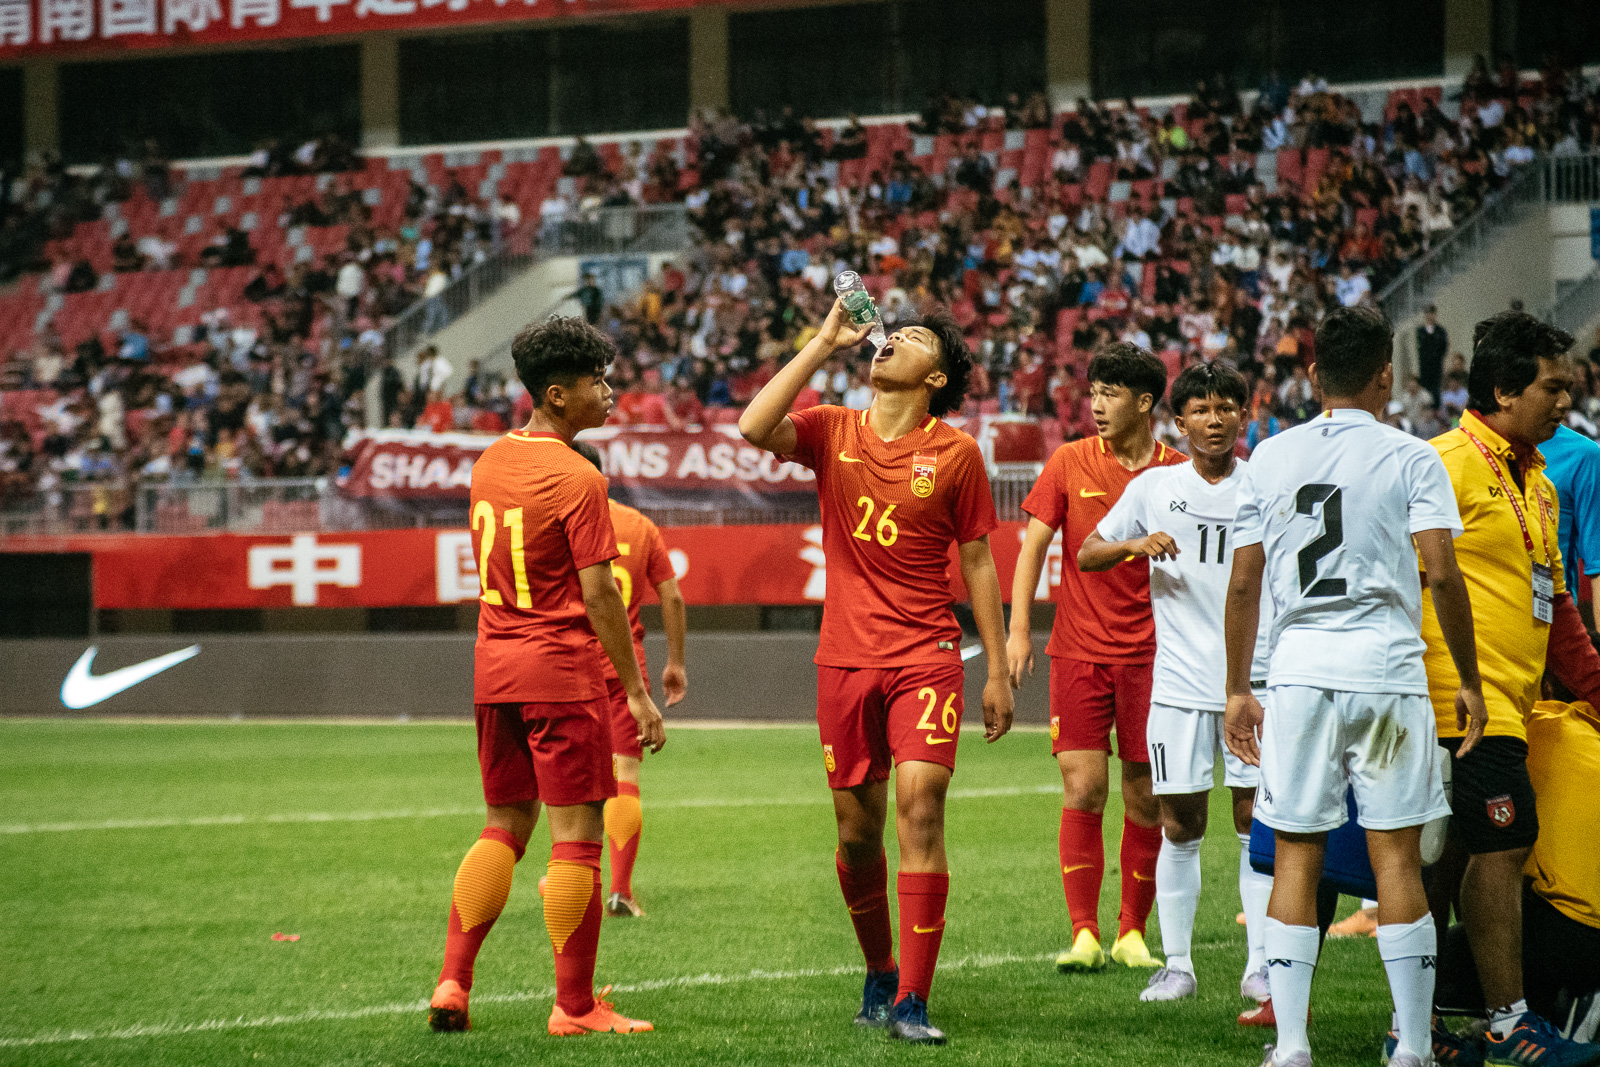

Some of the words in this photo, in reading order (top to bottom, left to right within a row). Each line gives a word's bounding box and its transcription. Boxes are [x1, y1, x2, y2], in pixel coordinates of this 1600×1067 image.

[370, 453, 472, 489] SHAA
[600, 441, 669, 478] NS
[853, 496, 898, 547] 26
[1197, 524, 1227, 564] 11
[1296, 484, 1347, 598] 2
[472, 500, 533, 609] 21
[916, 687, 957, 734] 26
[1152, 743, 1167, 782] 11
